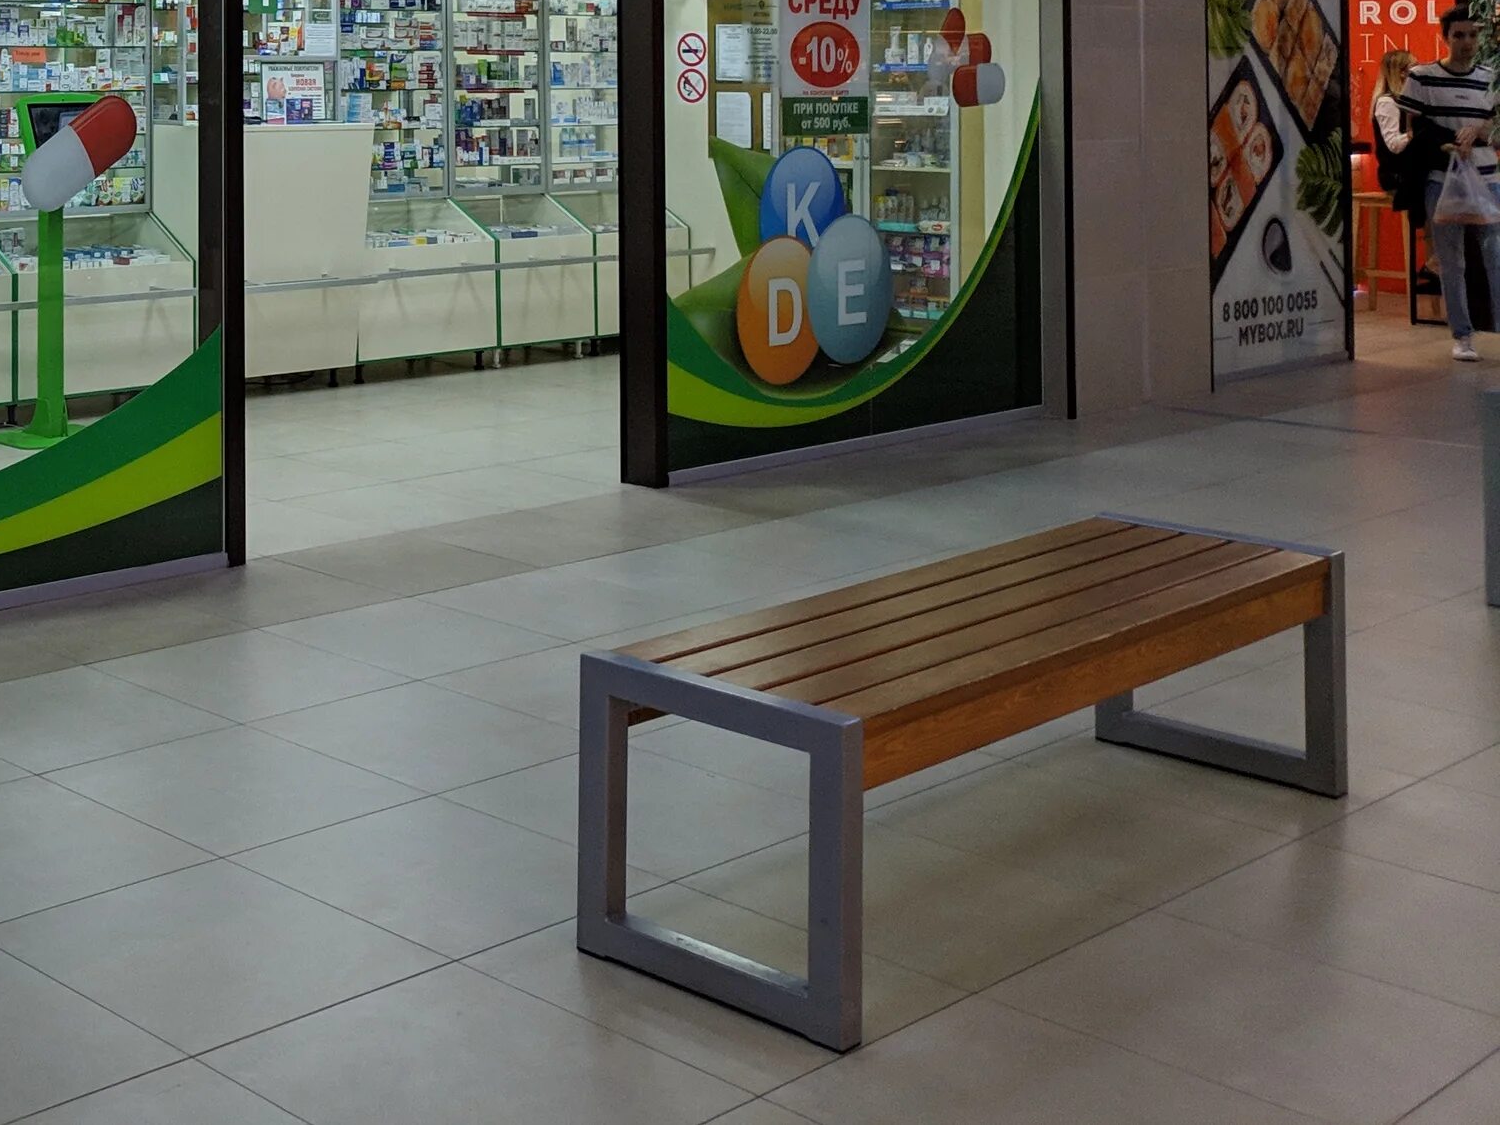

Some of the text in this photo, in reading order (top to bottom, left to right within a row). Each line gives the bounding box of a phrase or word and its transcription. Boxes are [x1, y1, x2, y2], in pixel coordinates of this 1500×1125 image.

[799, 36, 855, 73] -10%
[793, 102, 859, 115] ПРИ ПОКУПКЕ
[802, 116, 851, 131] от 500 руб.
[787, 180, 821, 249] K
[837, 258, 867, 326] E
[1223, 289, 1318, 322] 8 800 100 0055
[768, 277, 803, 347] D
[1238, 317, 1304, 347] MYBOX.RU
